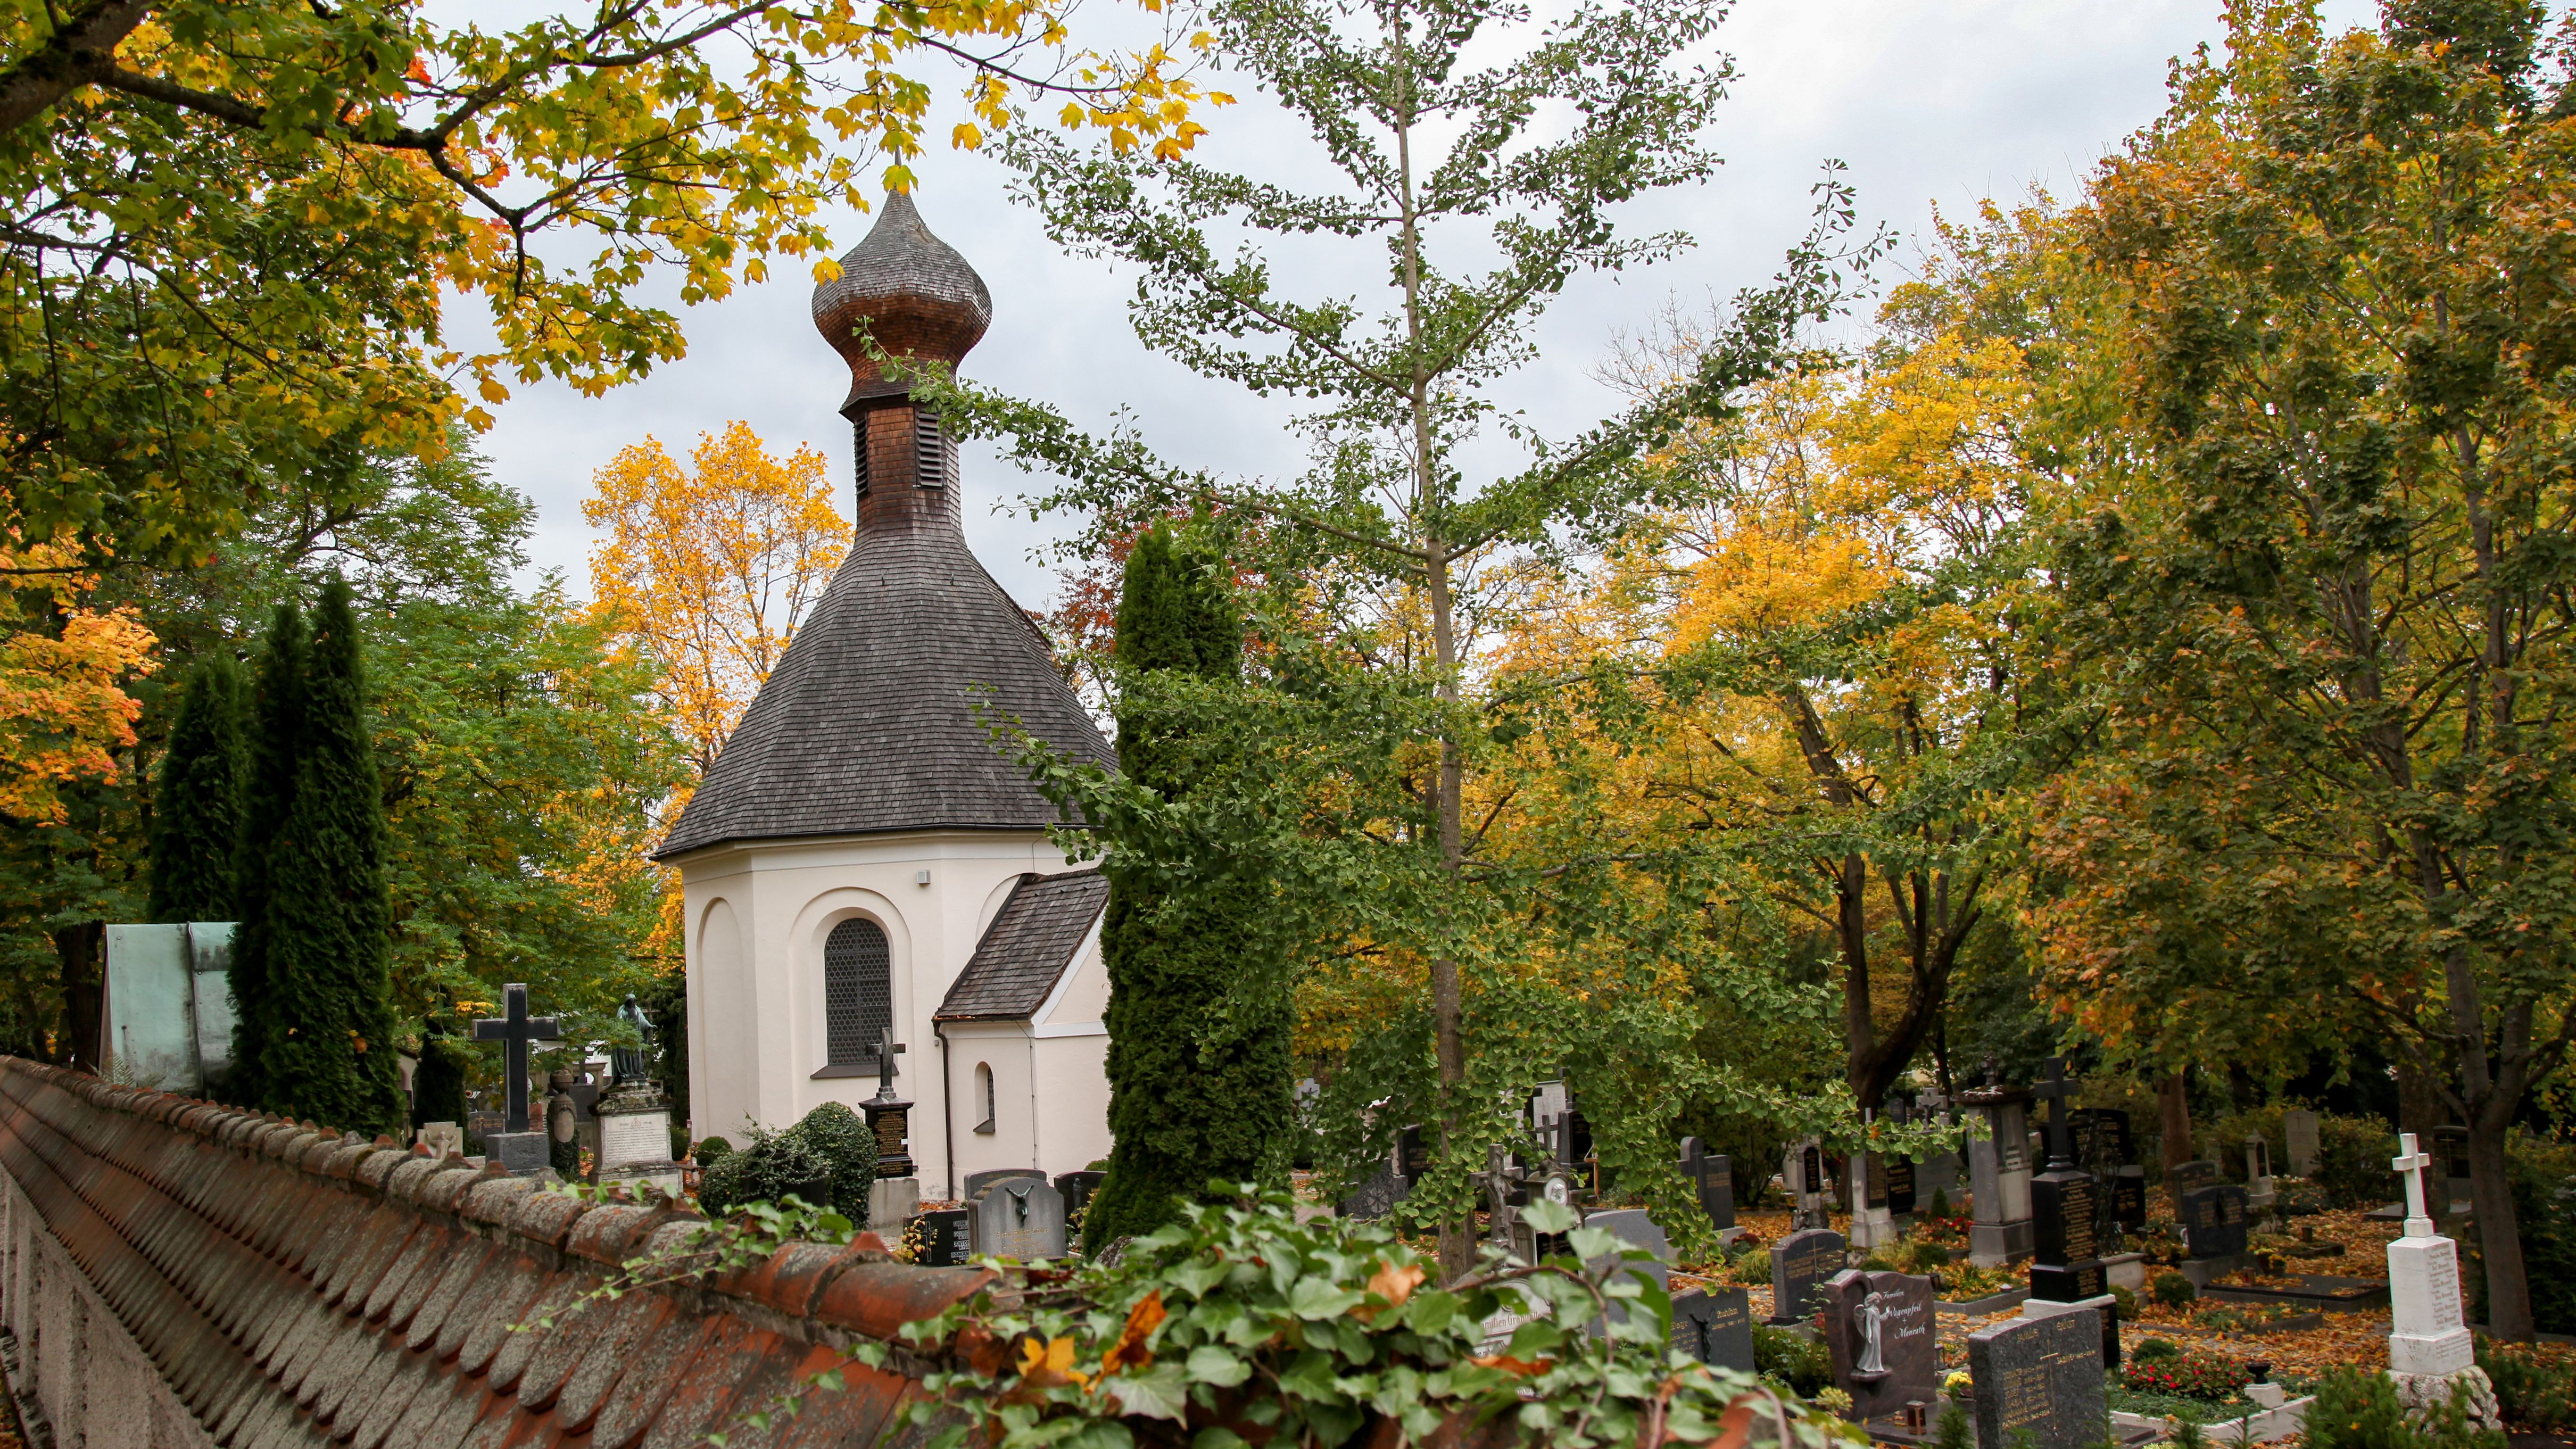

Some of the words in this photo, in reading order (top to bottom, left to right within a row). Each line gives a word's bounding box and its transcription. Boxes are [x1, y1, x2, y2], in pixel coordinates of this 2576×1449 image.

[1883, 1289, 1904, 1299] Familien
[1890, 1300, 1923, 1319] Wagenpfeil
[1894, 1322, 1926, 1339] Menrath
